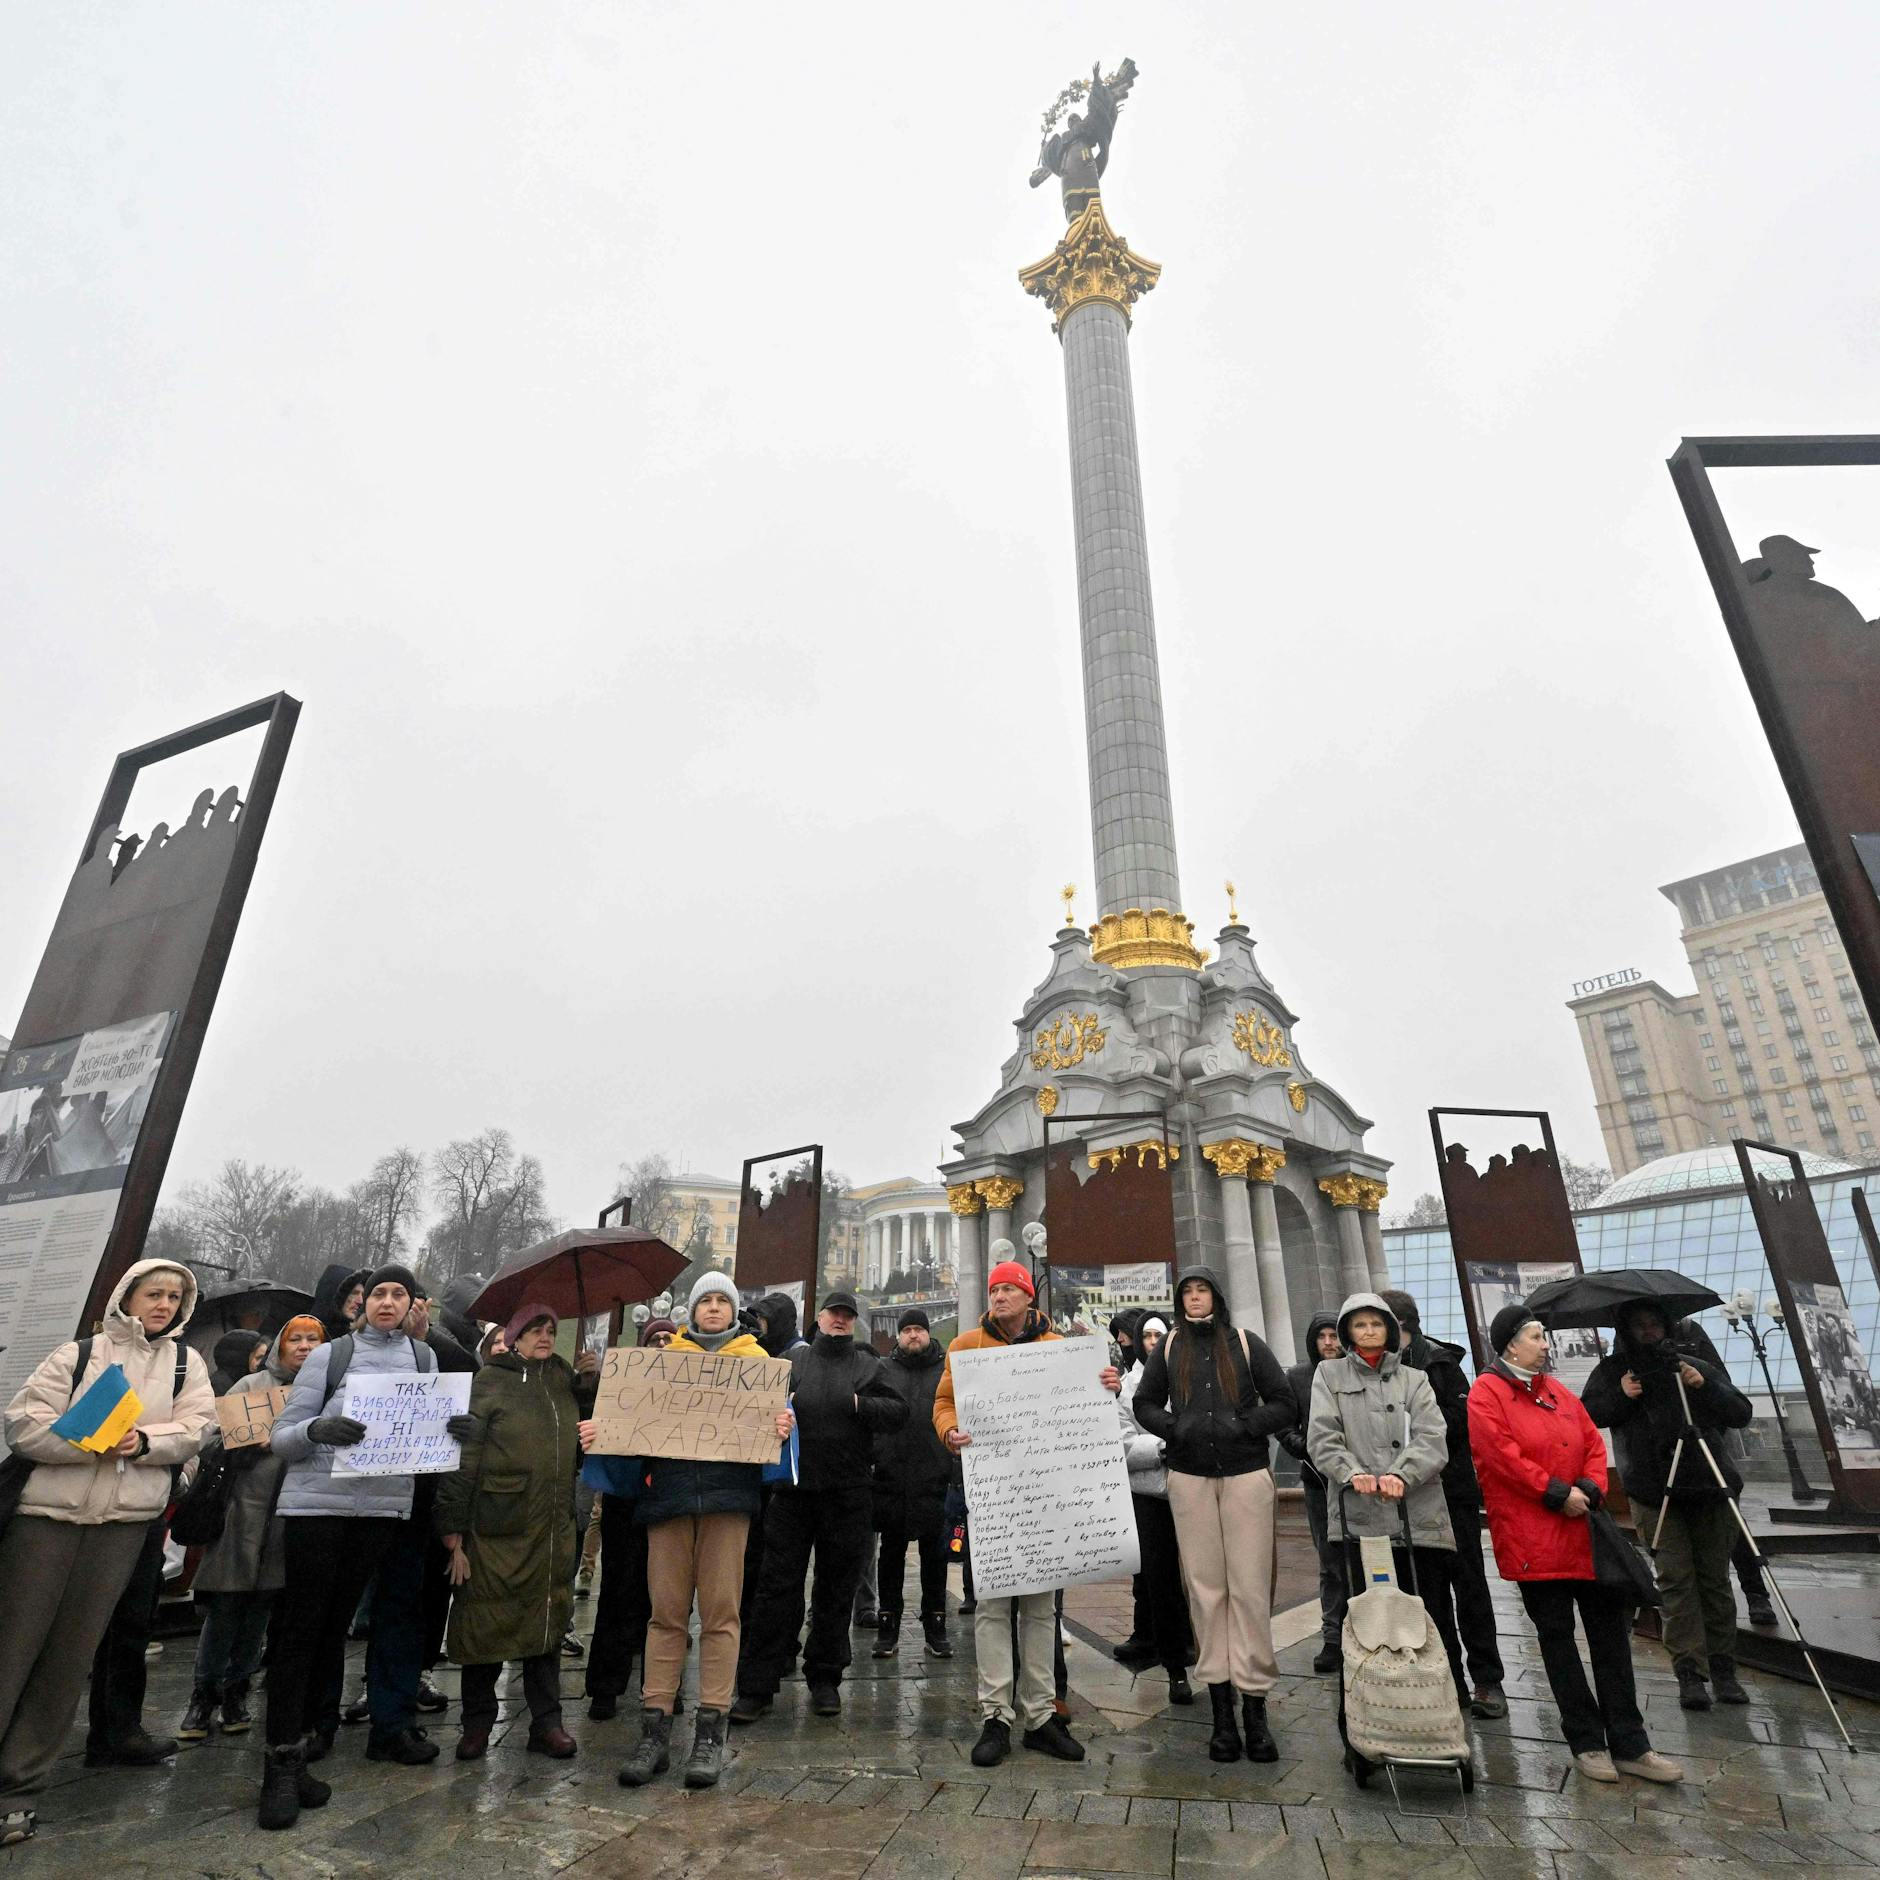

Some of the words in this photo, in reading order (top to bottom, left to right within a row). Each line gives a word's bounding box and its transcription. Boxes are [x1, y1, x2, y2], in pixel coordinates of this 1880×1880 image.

[1571, 967, 1642, 996] ГОТЕЛЬ
[602, 1350, 791, 1394] ЗРАДНИКАМ
[395, 1377, 437, 1396] ТАК!
[352, 1396, 426, 1408] ВИБОРАМ
[435, 1397, 452, 1408] ТА
[352, 1409, 404, 1421] ЗМІНІ
[965, 1409, 1039, 1426] Президента
[390, 1422, 413, 1435] НІ
[1031, 1417, 1099, 1430] Володимира
[344, 1433, 447, 1449] СИФІКАЦІЇ
[345, 1452, 412, 1466] ЗАКОНУ
